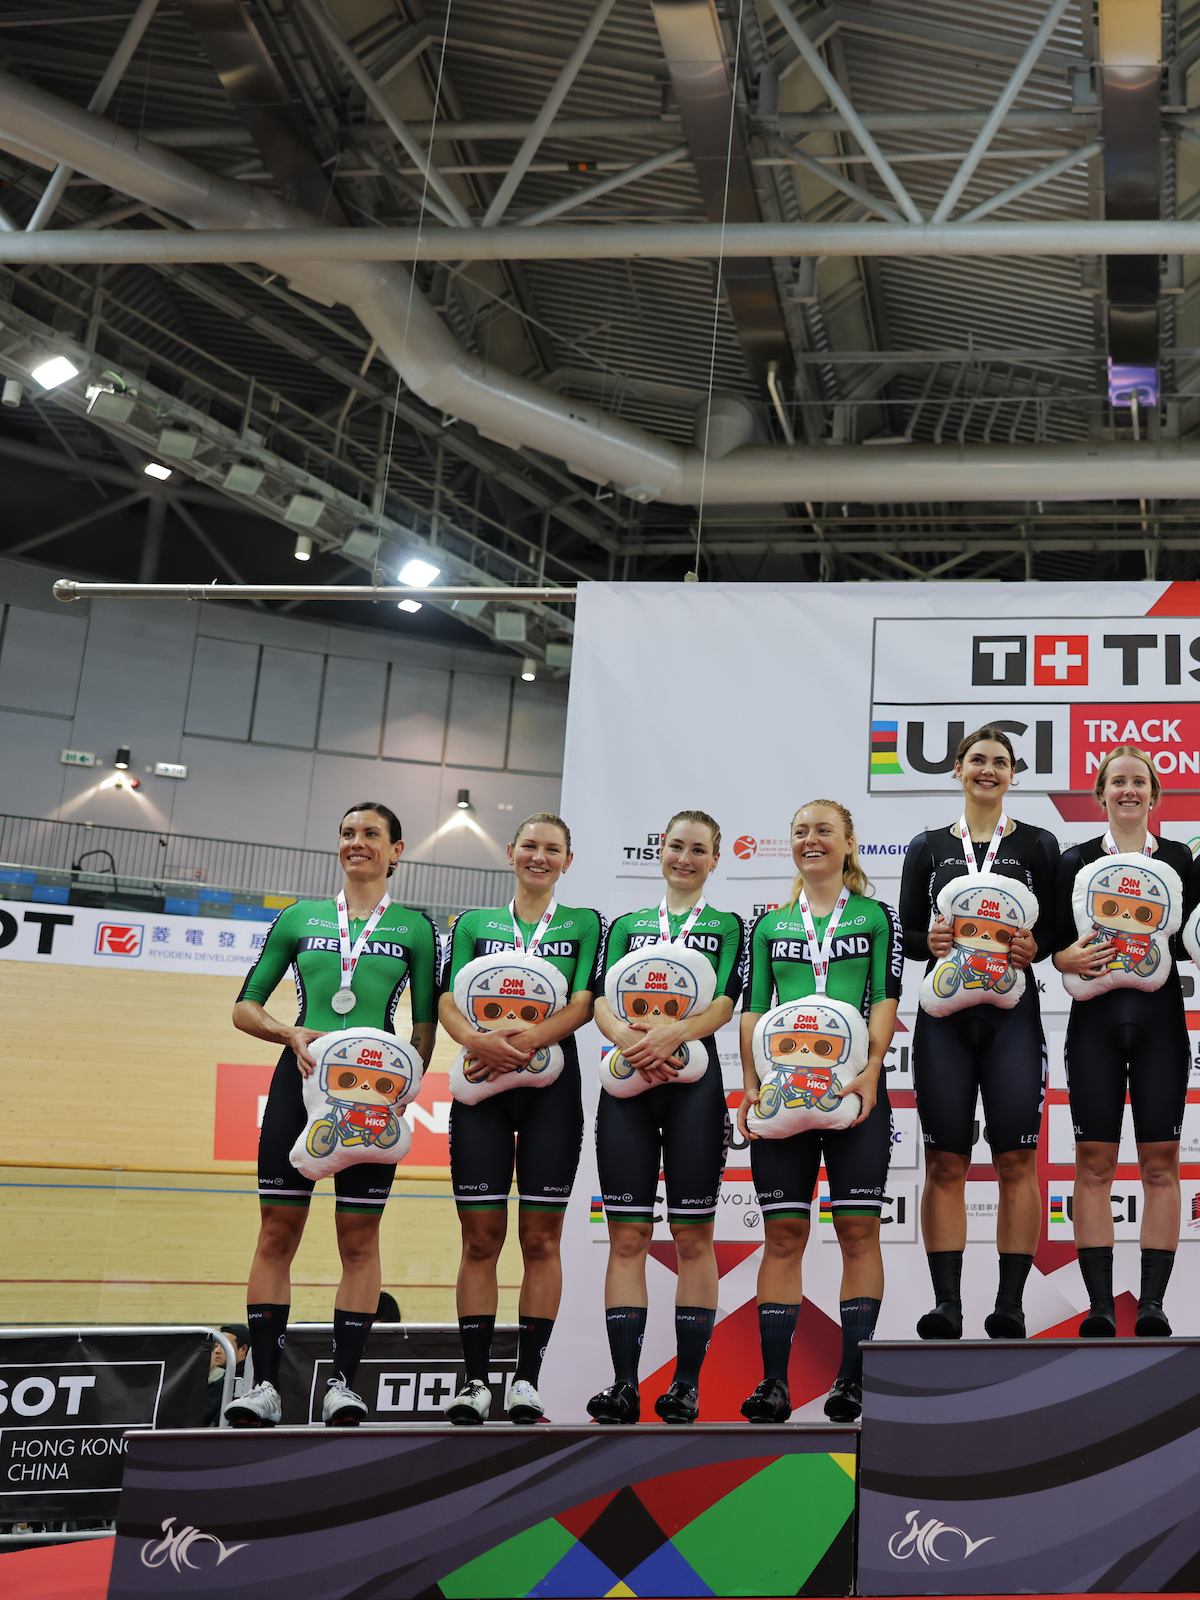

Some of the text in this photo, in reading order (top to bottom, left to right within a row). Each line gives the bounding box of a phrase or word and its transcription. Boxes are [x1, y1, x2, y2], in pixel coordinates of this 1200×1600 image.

[1084, 719, 1182, 743] TRACK
[1121, 877, 1140, 889] DIN
[1117, 886, 1142, 897] DONG
[981, 899, 1000, 911] DIN
[977, 908, 1001, 919] DONG
[307, 937, 404, 958] IREAND
[887, 906, 904, 978] IRELAND
[149, 949, 192, 960] RYODEN
[1125, 945, 1146, 956] HKG
[985, 963, 1005, 974] HKG
[648, 972, 667, 982] DIN
[503, 978, 523, 988] DIN
[644, 982, 668, 990] DONG
[499, 988, 526, 996] DONG
[797, 1014, 817, 1024] DIN
[793, 1023, 819, 1031] DONG
[361, 1048, 383, 1060] DIN
[356, 1057, 383, 1068] DONG
[806, 1079, 828, 1091] HKG
[365, 1117, 386, 1127] HKG
[11, 1437, 129, 1458] HONG KON
[7, 1463, 69, 1482] CHINA
